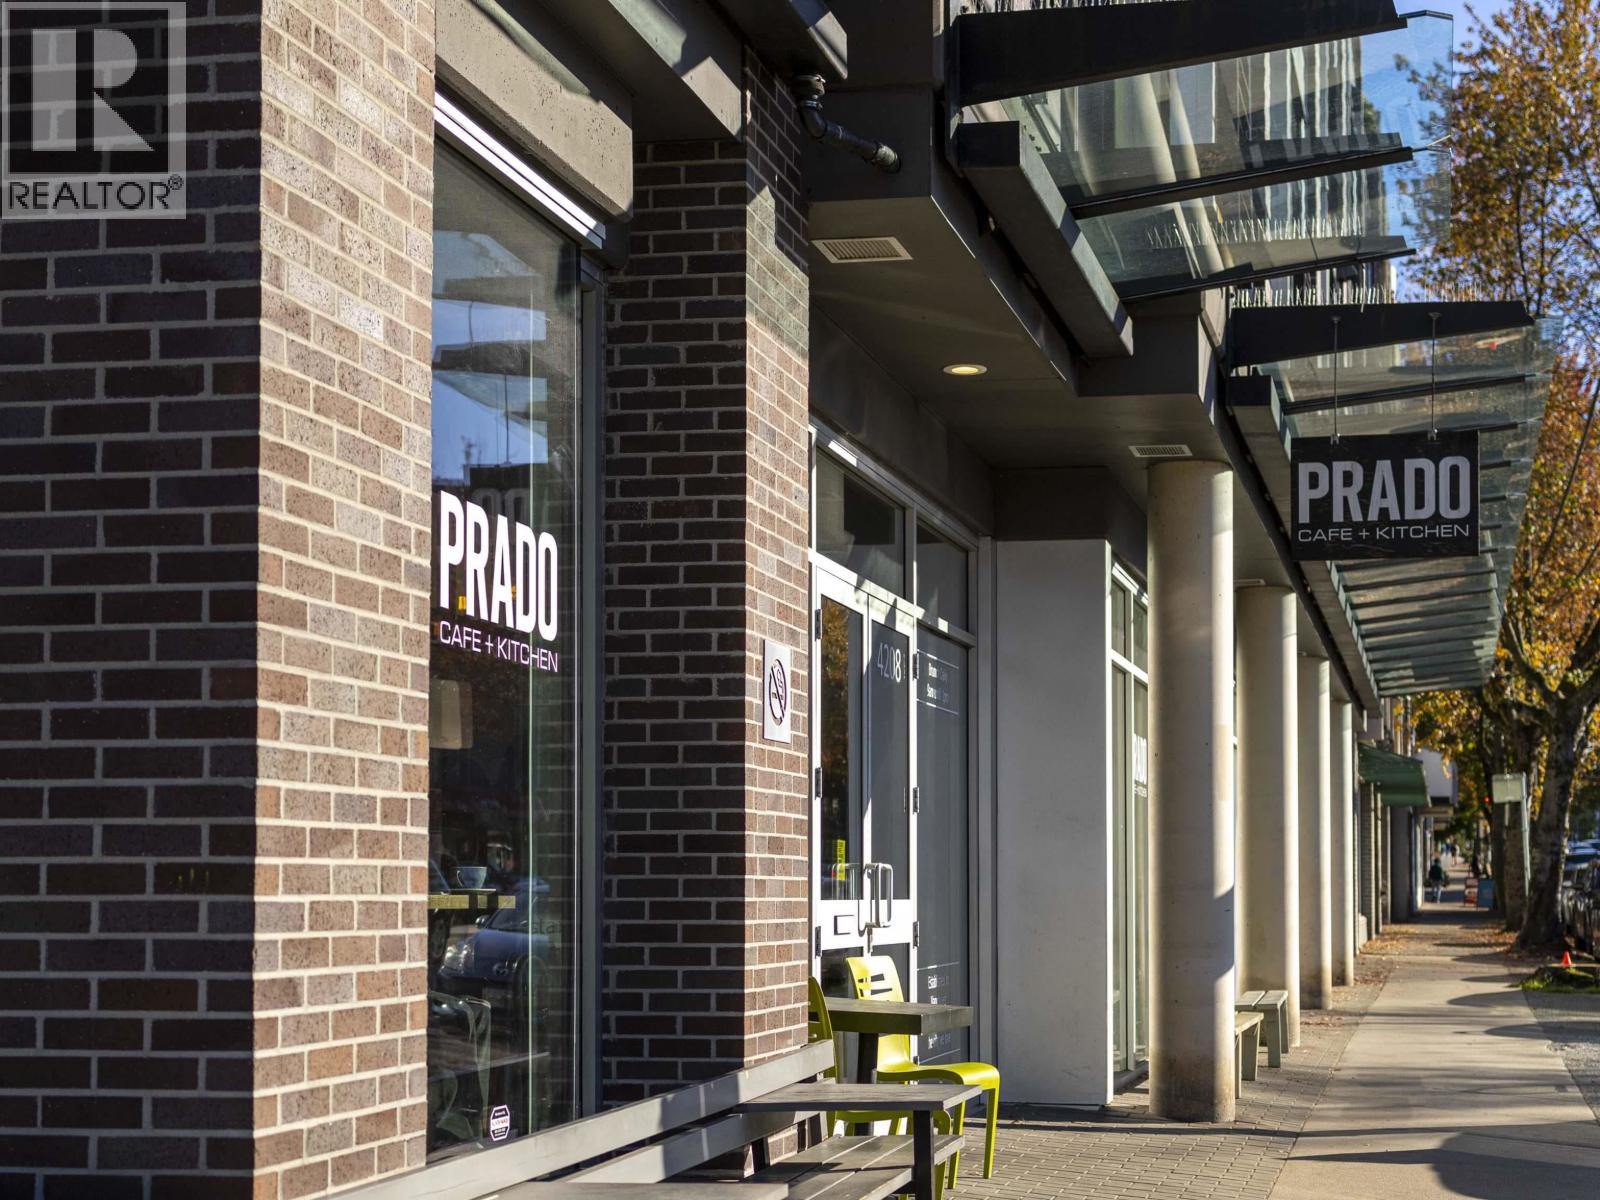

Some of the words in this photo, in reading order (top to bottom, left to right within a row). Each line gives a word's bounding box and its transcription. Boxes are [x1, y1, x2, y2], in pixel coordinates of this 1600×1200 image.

[1298, 455, 1471, 524] PRADO
[1298, 528, 1353, 542] CAFE
[1376, 524, 1470, 540] KITCHEN
[439, 489, 558, 642] PRADO
[439, 620, 482, 653] CAFE
[497, 635, 559, 673] KITCHEN
[877, 642, 902, 683] 4208
